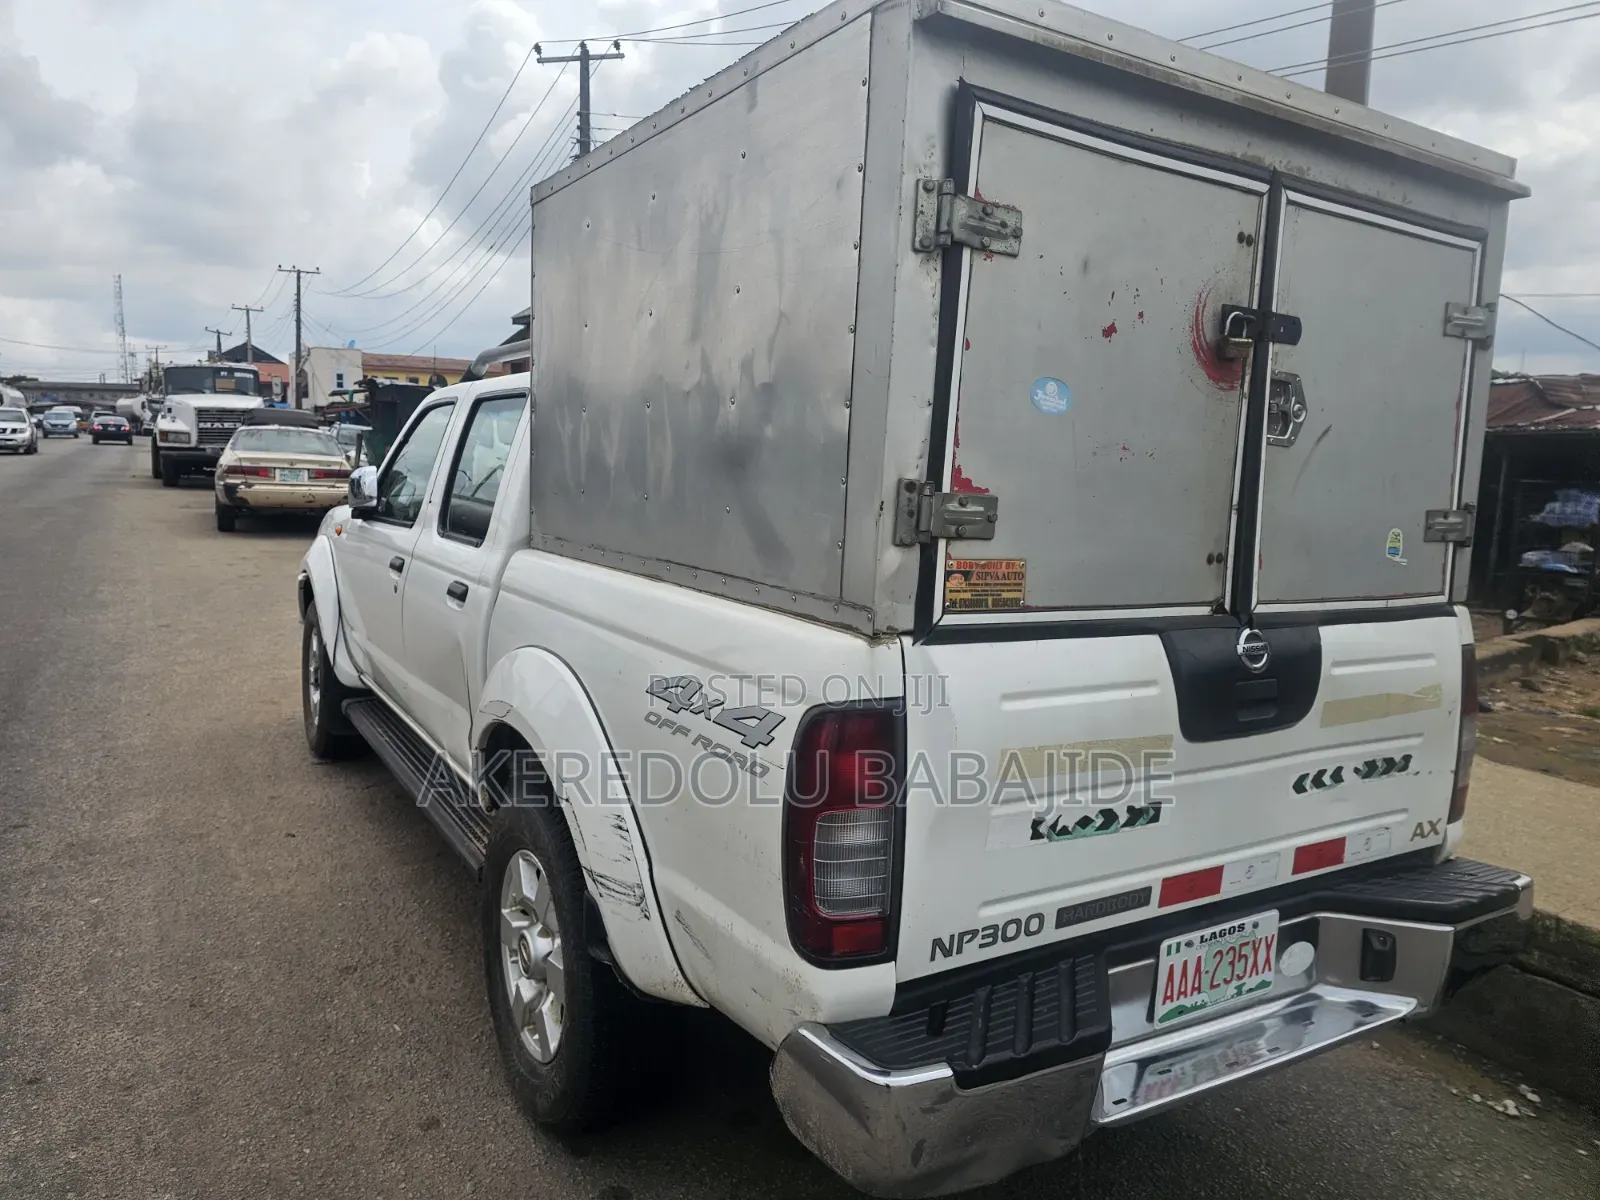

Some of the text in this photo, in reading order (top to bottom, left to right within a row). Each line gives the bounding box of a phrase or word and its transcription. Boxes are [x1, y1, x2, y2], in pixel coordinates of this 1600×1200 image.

[975, 571, 1024, 581] SIPVA AUTO
[644, 711, 771, 779] OFF ROAD
[1410, 818, 1442, 842] AX
[929, 892, 1150, 962] NP300 HARDBODY
[1199, 922, 1246, 944] LAGOS
[1161, 934, 1276, 1005] AAA-235XX
